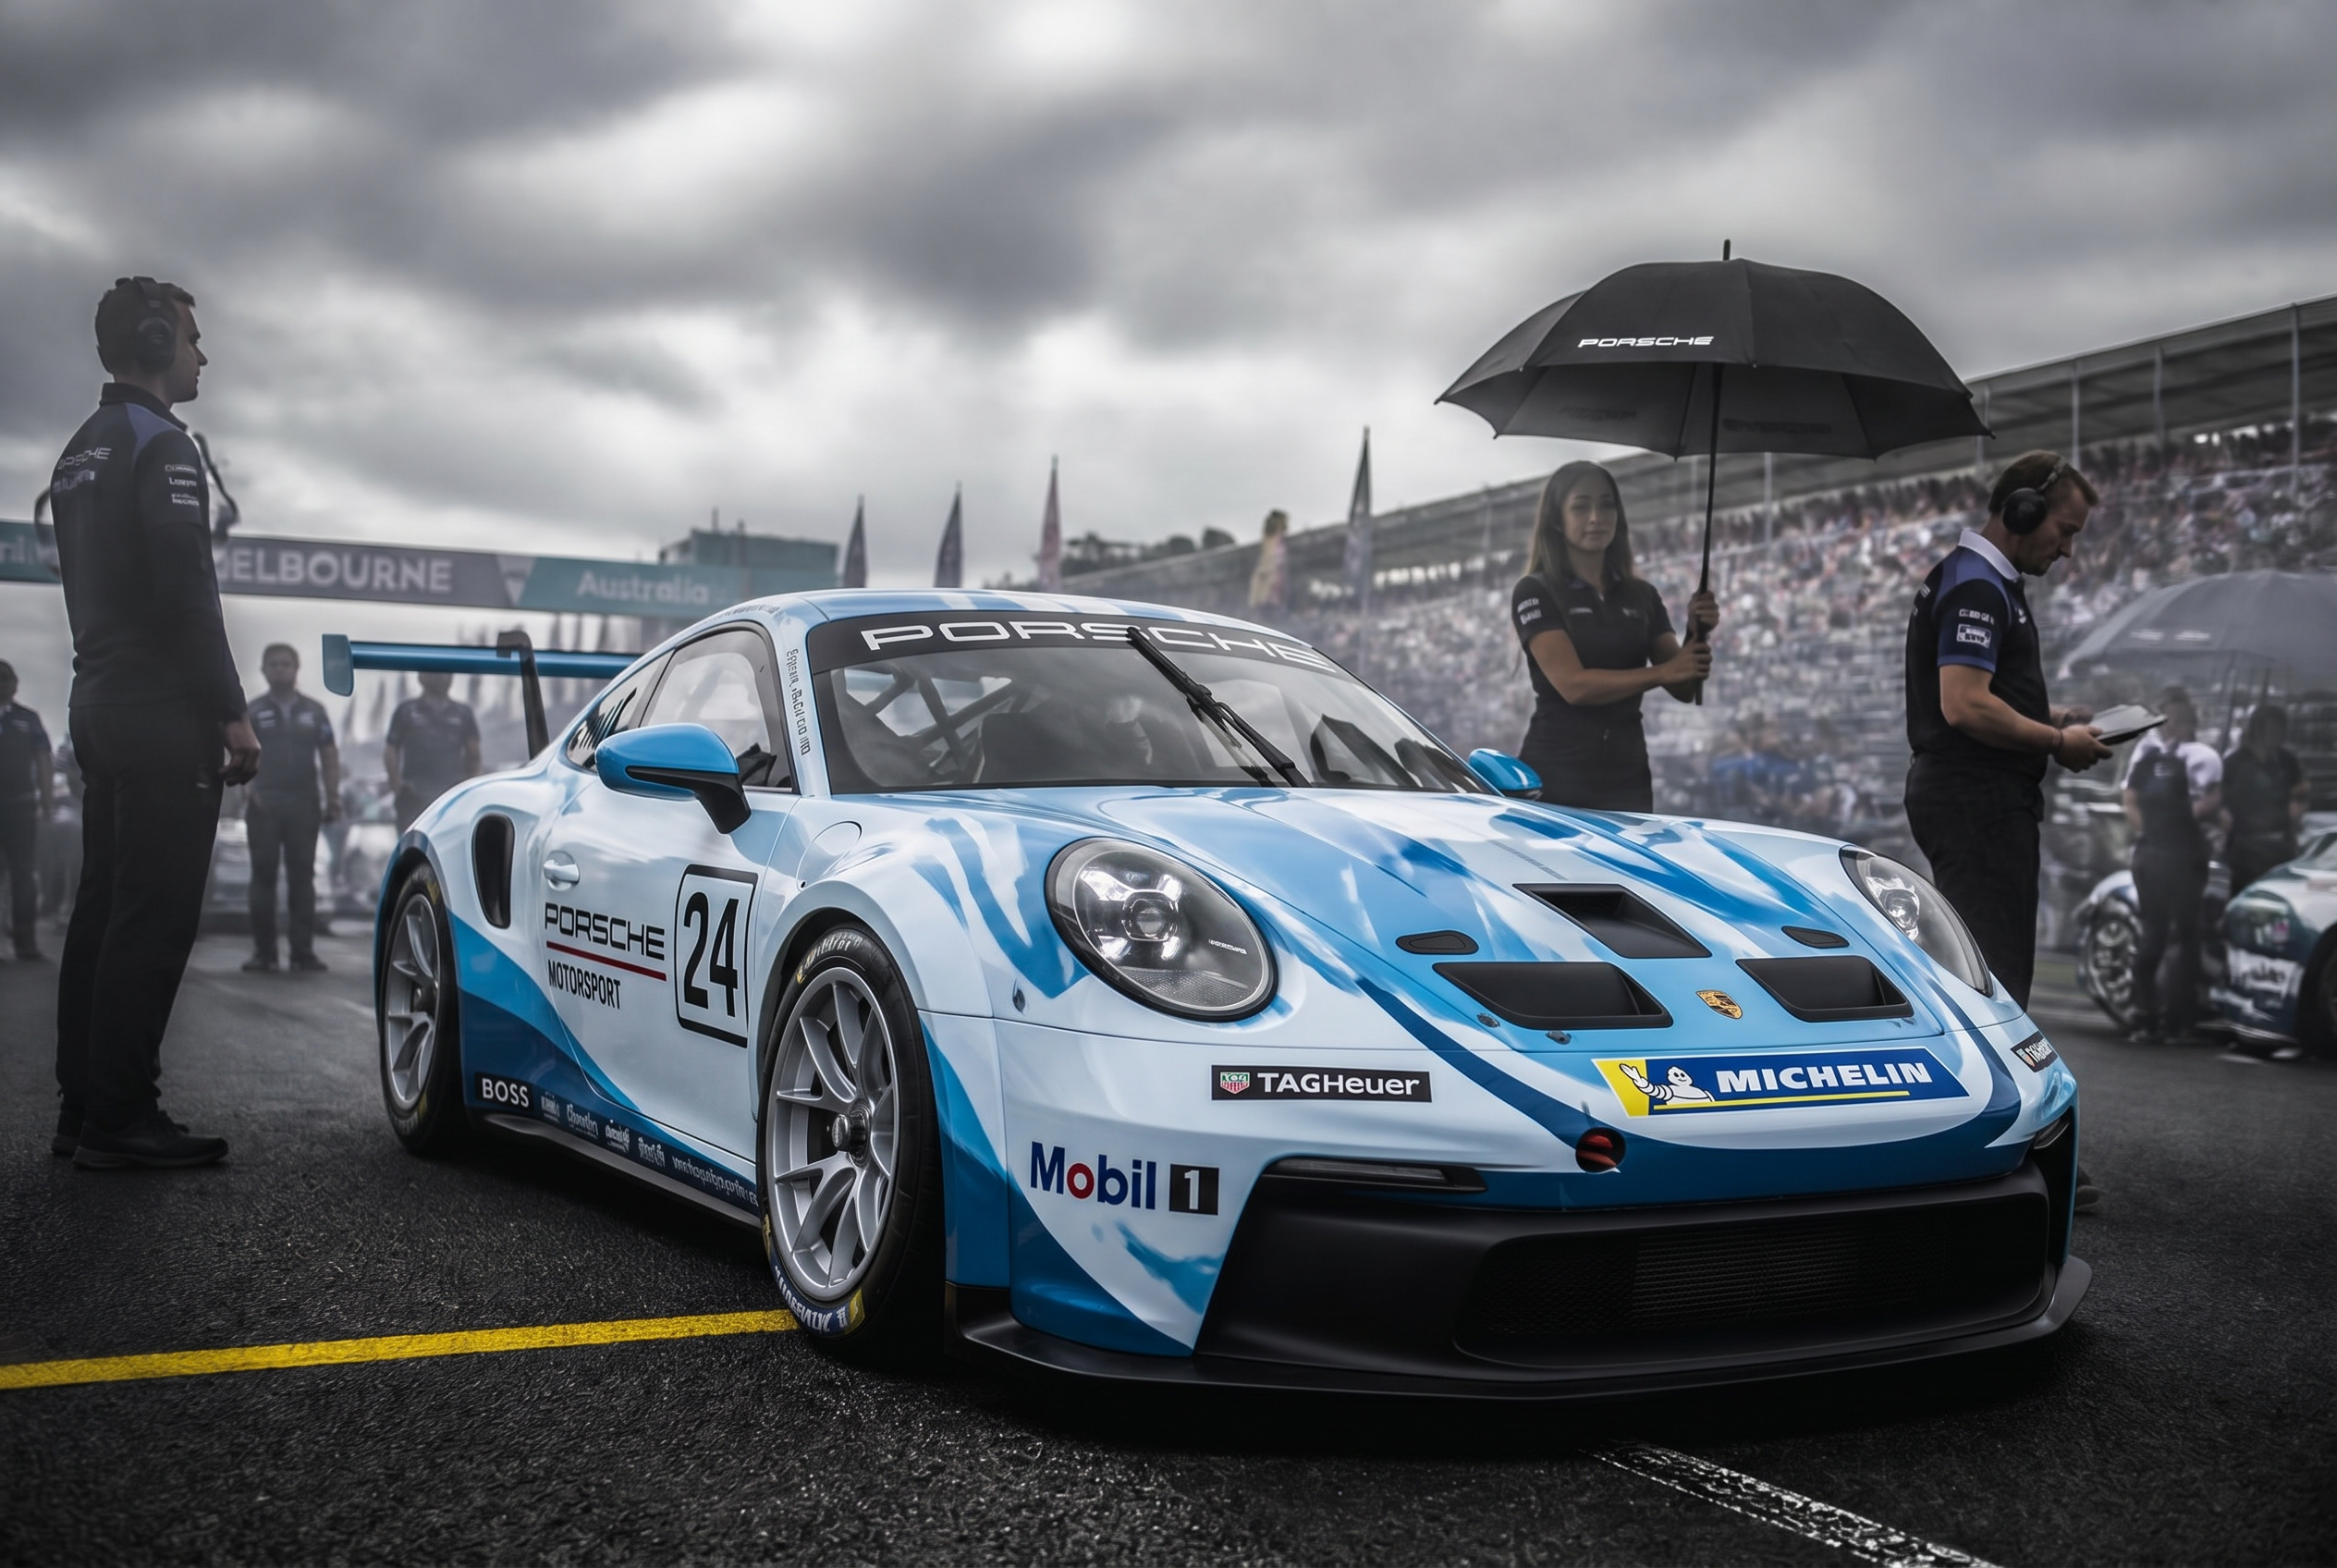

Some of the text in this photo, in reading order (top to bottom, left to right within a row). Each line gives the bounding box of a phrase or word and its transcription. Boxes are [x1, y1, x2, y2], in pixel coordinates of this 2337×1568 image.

[1577, 336, 1714, 349] PORSCHE
[577, 570, 711, 606] Australia
[860, 620, 1339, 673] PORSCHE
[545, 902, 665, 962] PORSCHE
[683, 891, 740, 1017] 24
[548, 960, 620, 1010] MOTORSPORT
[482, 1077, 530, 1108] BOSS
[1716, 1062, 1933, 1093] MICHELIN
[1030, 1141, 1200, 1210] Mobil 1
